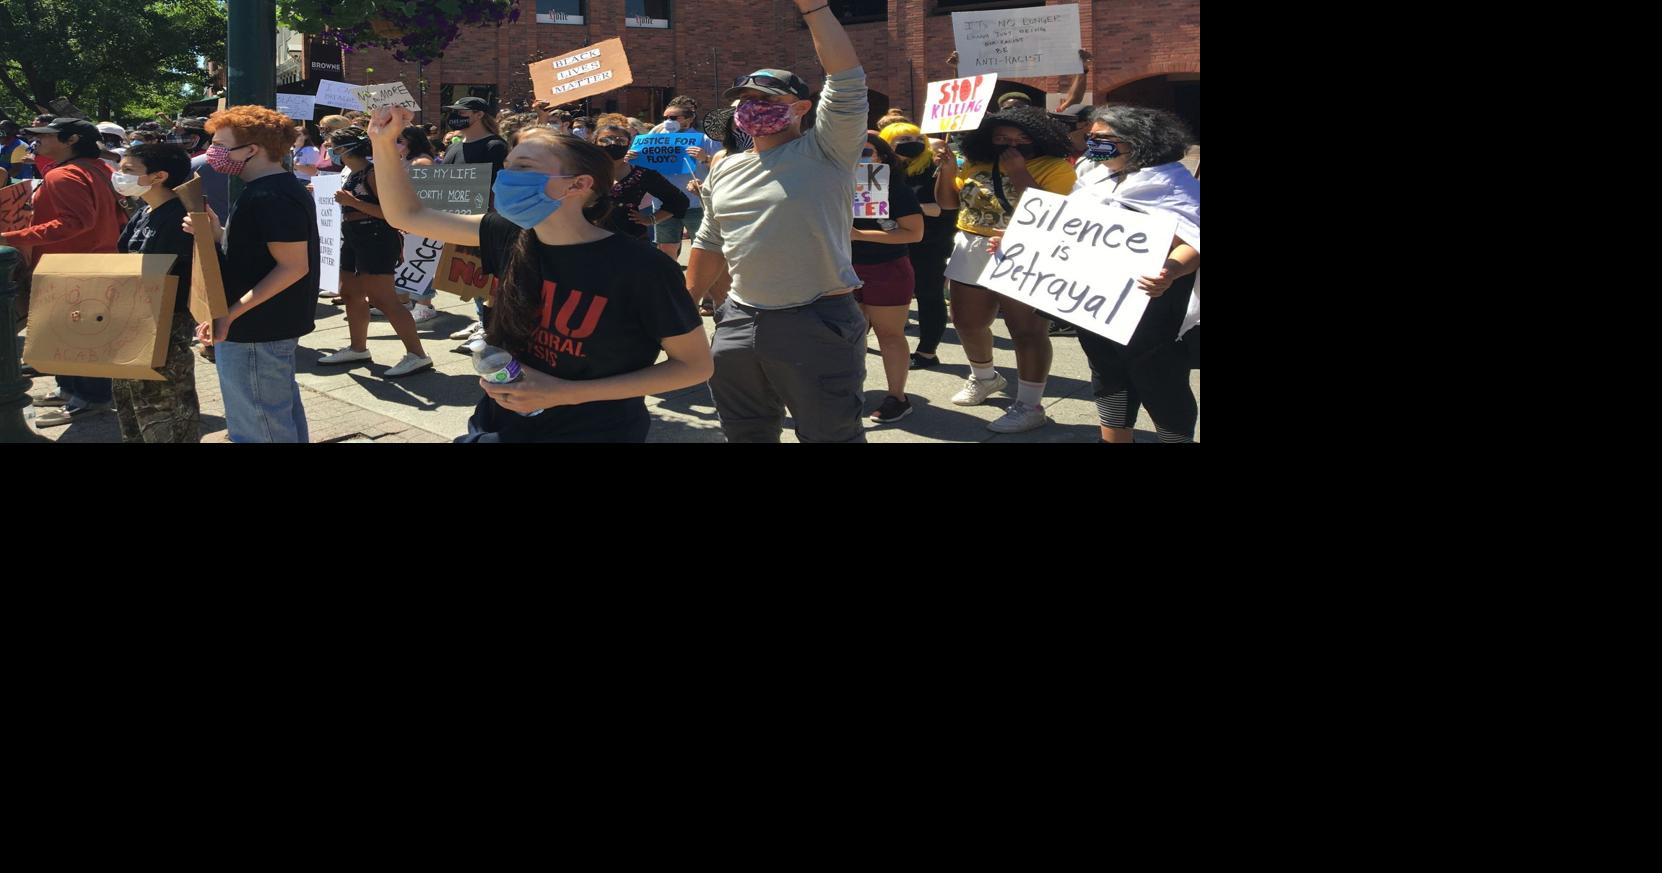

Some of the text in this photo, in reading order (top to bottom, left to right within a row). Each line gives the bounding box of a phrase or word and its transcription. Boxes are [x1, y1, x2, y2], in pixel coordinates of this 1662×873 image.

[311, 61, 341, 71] BROWNE
[554, 50, 598, 68] BLACK
[975, 53, 1043, 67] ANTI-RACIST
[559, 62, 600, 79] LIVES
[554, 71, 610, 93] MATTER
[379, 85, 409, 100] MORE
[931, 99, 983, 120] KILLING
[939, 114, 967, 131] US!
[635, 136, 697, 146] JUSTICE FOR
[641, 145, 681, 155] GEORGE
[646, 154, 677, 164] FLOYD
[433, 168, 449, 179] MY
[450, 167, 478, 180] LIFE
[447, 189, 471, 202] MORE
[1016, 197, 1150, 254] Silence
[1050, 240, 1071, 262] is
[395, 237, 443, 292] PEACE
[989, 243, 1135, 326] Betrayal
